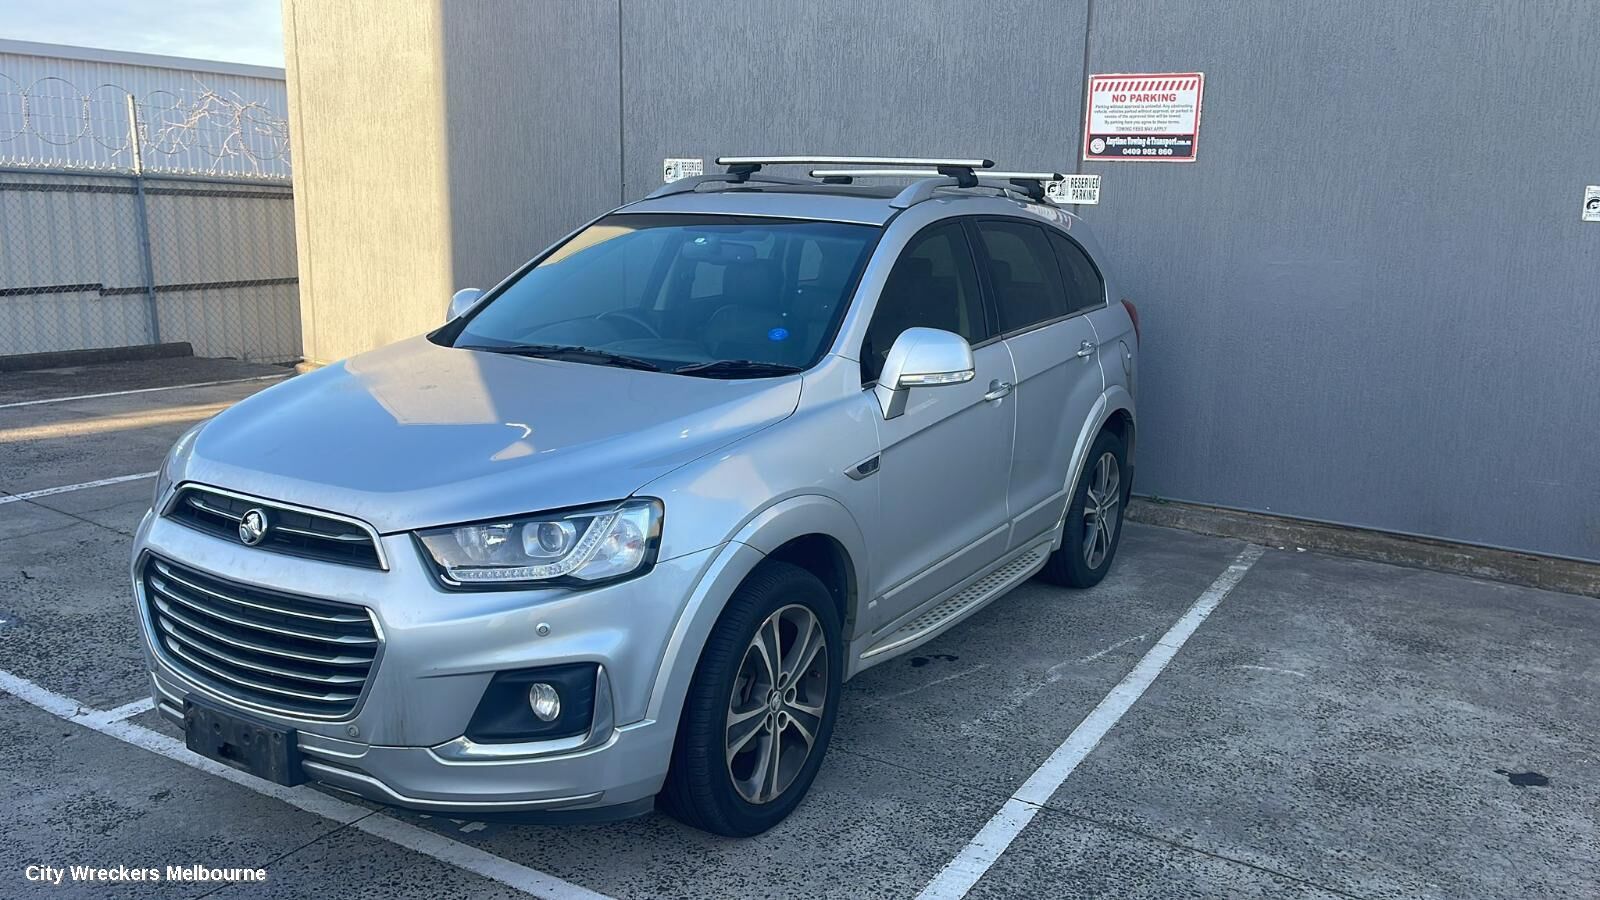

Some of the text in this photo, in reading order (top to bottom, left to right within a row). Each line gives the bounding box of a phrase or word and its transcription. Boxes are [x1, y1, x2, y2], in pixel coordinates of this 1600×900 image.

[1112, 93, 1177, 103] NO PARKING
[1127, 136, 1146, 148] Towing
[682, 162, 702, 171] RESERVED
[1070, 178, 1098, 188] RESERVED
[1072, 190, 1096, 200] PARKING
